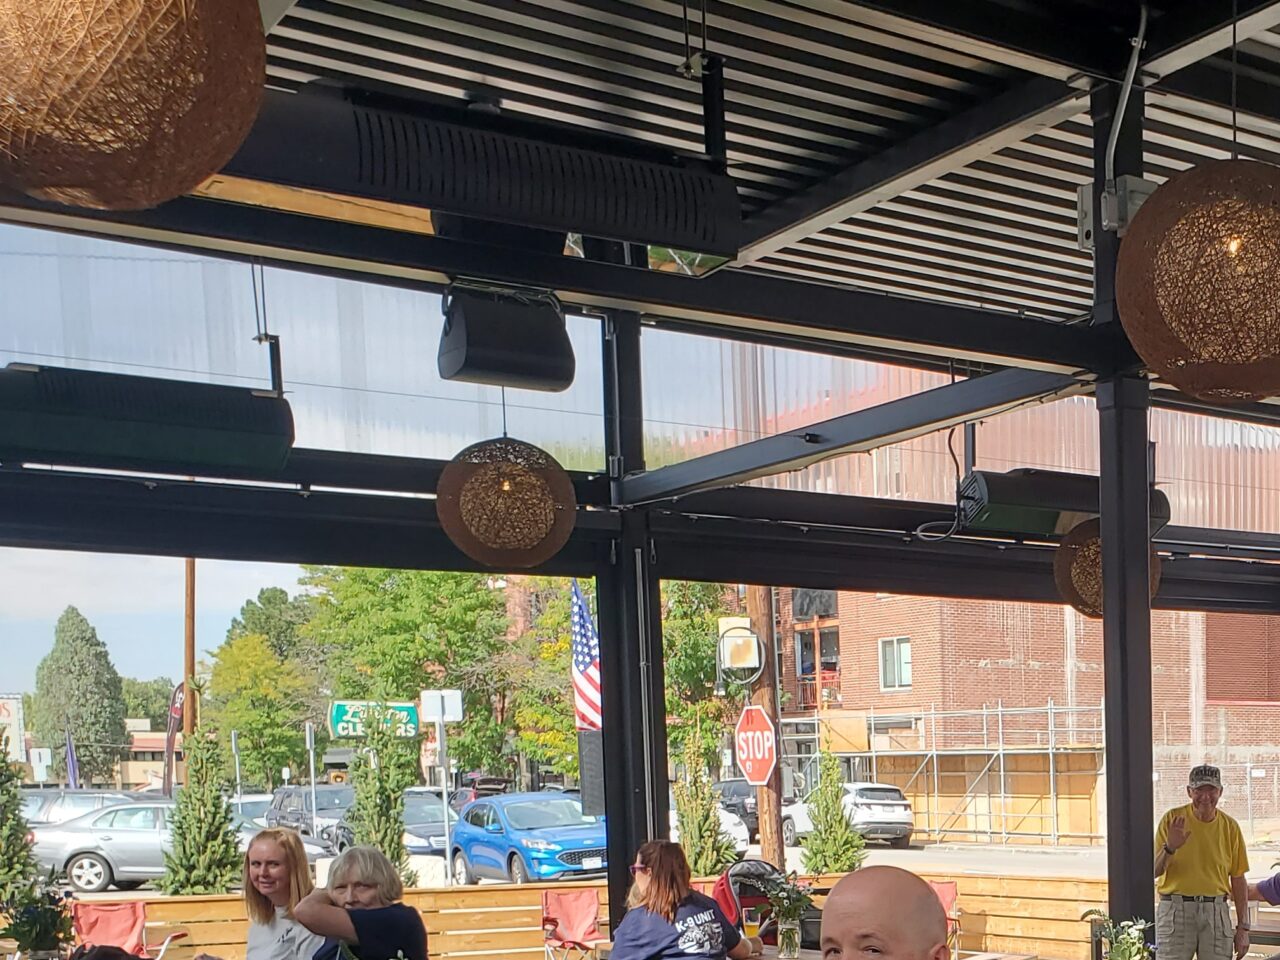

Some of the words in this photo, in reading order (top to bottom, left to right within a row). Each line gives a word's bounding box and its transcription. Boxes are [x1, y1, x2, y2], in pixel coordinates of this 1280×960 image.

[739, 730, 772, 760] STOP
[675, 916, 695, 933] K-9
[693, 909, 716, 925] UNIT
